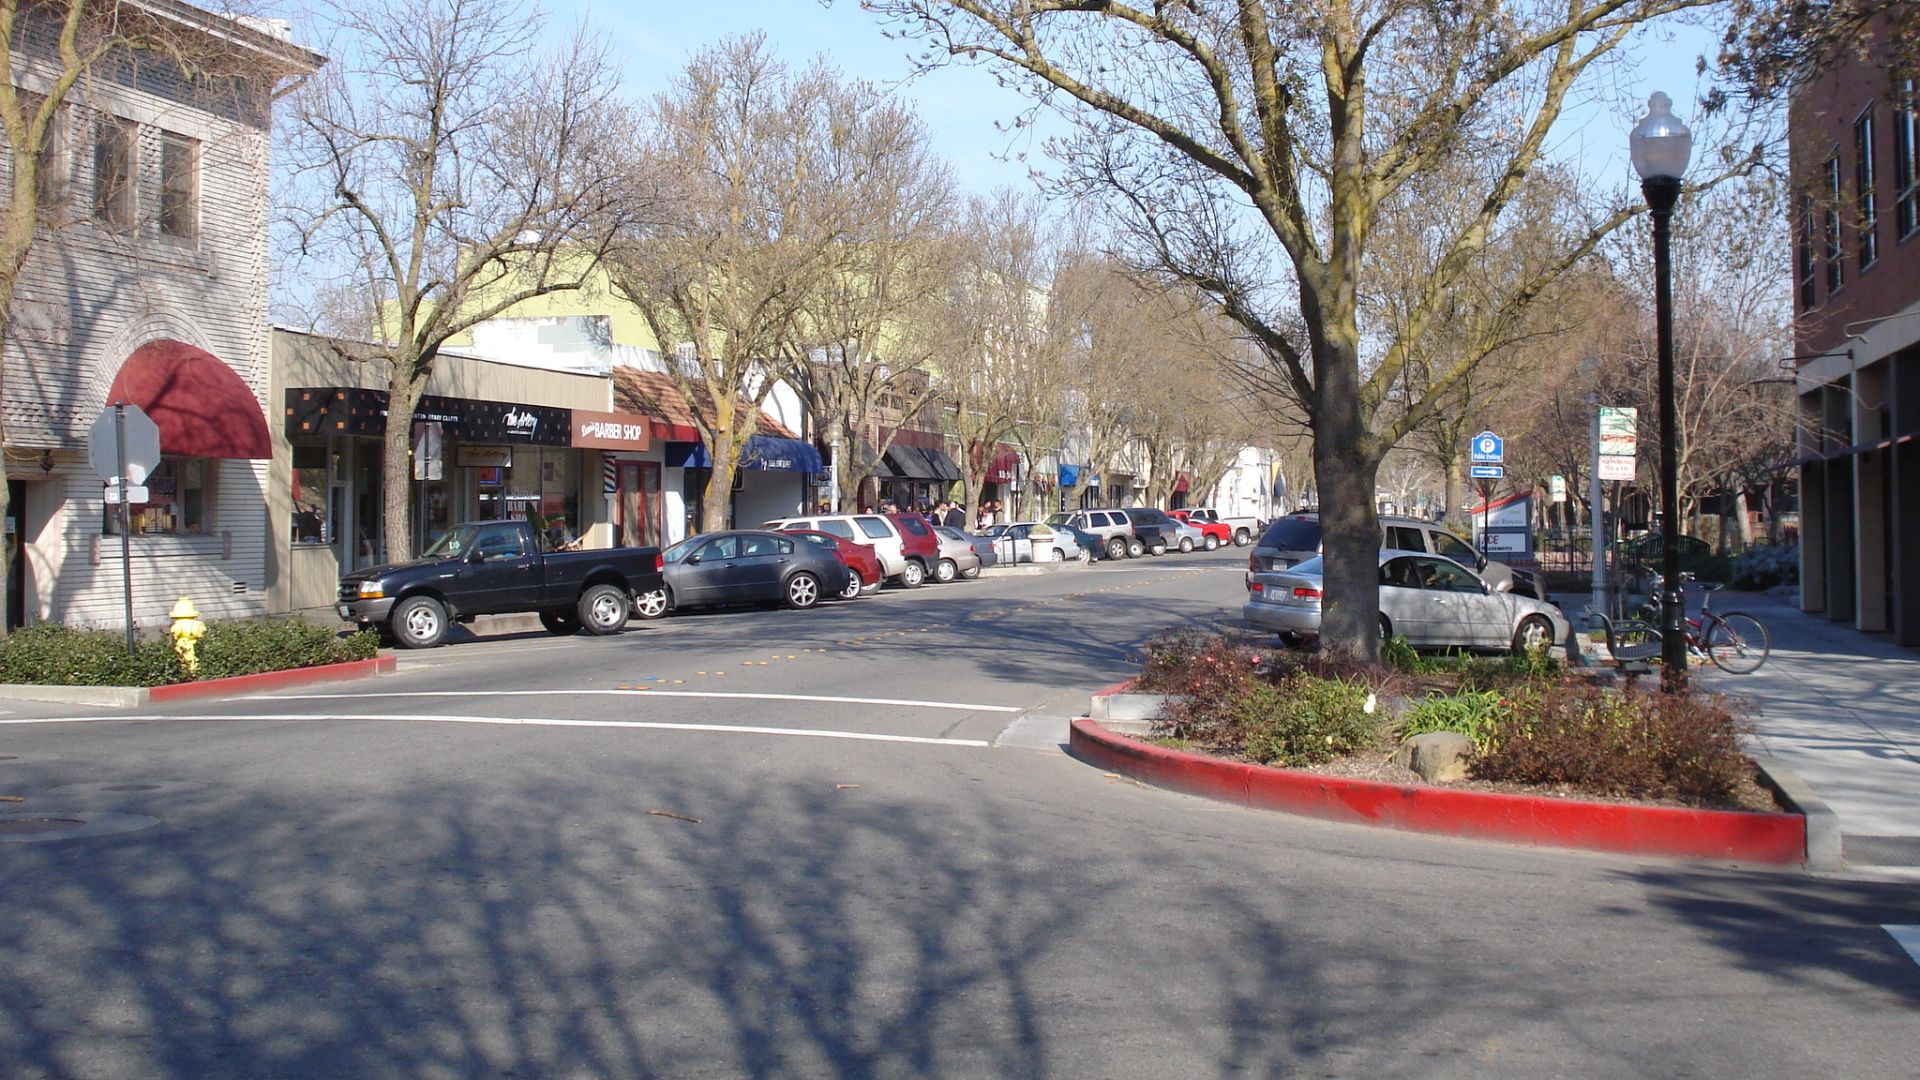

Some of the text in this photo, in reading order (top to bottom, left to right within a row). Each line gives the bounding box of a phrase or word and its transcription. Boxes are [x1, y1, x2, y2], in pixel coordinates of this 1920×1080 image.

[594, 422, 623, 440] BARBER
[623, 424, 642, 441] SHOP
[1484, 440, 1492, 451] P
[1486, 453, 1501, 461] Parking
